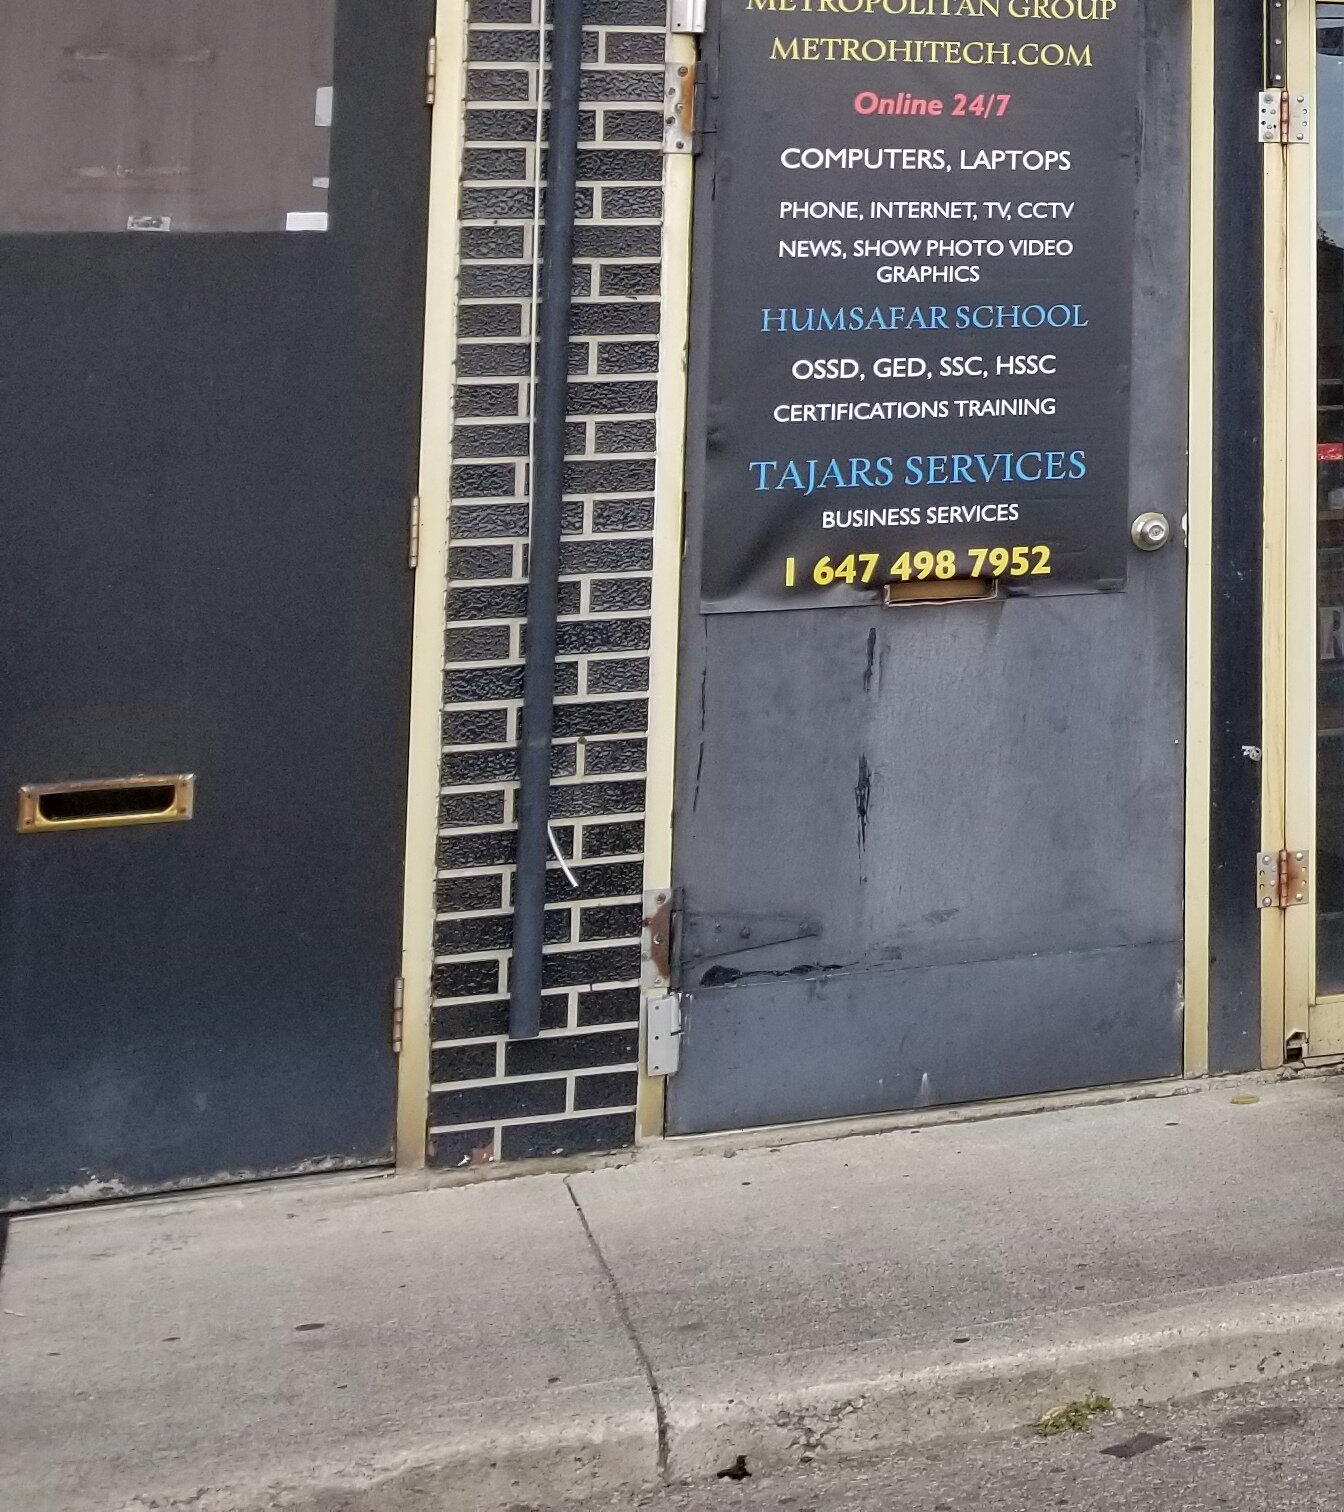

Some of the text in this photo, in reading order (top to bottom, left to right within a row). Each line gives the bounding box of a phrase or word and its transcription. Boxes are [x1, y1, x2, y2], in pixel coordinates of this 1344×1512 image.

[770, 37, 1093, 67] METROHITECH.COM
[854, 91, 1011, 119] Online 24/7
[781, 147, 1071, 173] COMPUTERS, LAPTOPS
[780, 201, 1075, 222] PHONE, INTERNET, TV, CCTV
[779, 239, 1073, 260] NEWS, SHOW PHOTO VIDEO
[876, 265, 980, 284] GRAPHICS
[761, 304, 1088, 332] HUMSAFAR SCHOOL
[791, 355, 1056, 382] OSSD, GED, SSC, HSSC
[773, 398, 1056, 423] CERTIFICATIONS TRAINING
[749, 451, 1087, 496] TAJARS SERVICES
[822, 504, 1019, 529] BUSINESS SERVICES
[813, 552, 880, 585] 647
[890, 550, 956, 581] 498
[968, 545, 1051, 577] 7952
